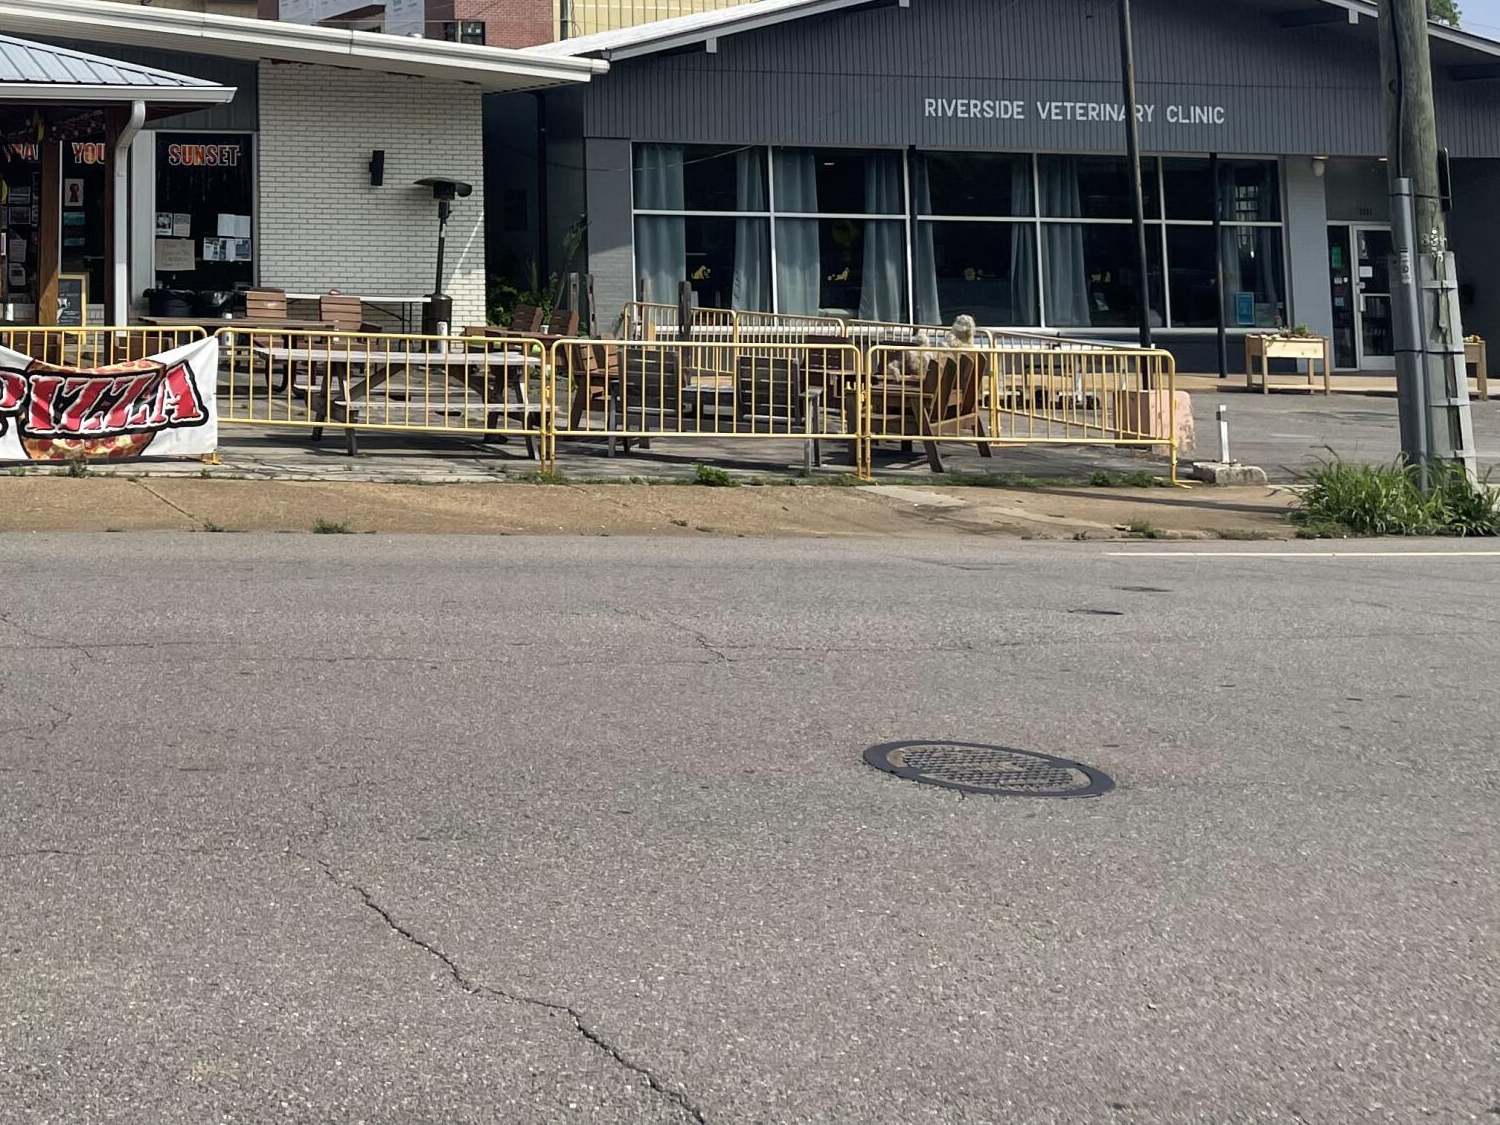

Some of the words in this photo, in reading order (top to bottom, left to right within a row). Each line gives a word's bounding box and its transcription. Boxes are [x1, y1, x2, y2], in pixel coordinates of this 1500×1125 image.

[924, 98, 1025, 120] RIVERSIDE
[1166, 105, 1225, 125] CLINIC
[71, 142, 106, 165] YOU
[168, 143, 240, 167] SUNSET
